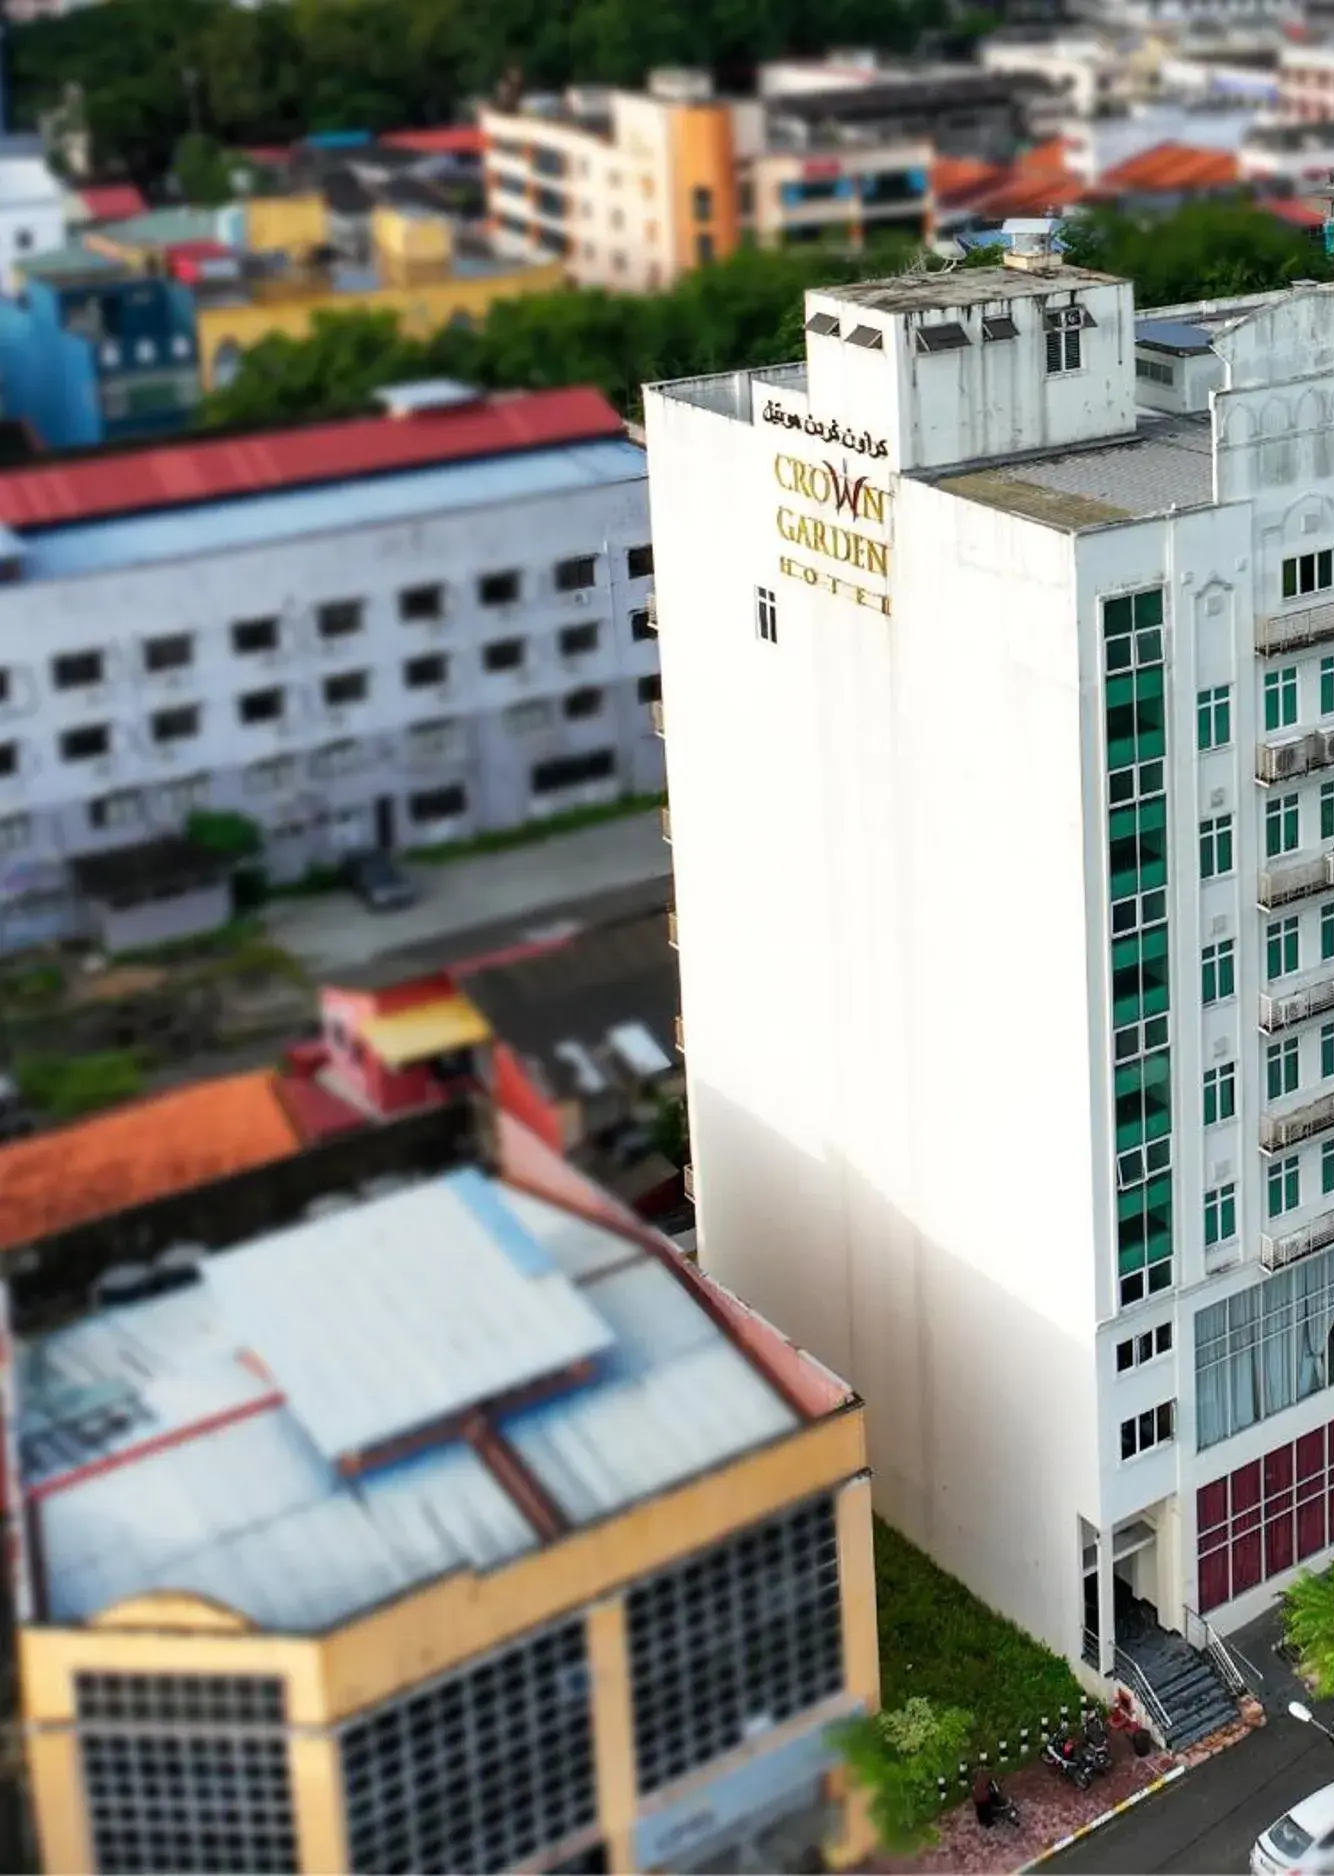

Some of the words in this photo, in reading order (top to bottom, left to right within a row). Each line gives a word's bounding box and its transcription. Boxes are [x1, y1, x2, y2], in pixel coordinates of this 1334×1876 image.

[774, 452, 885, 524] CROWN
[776, 505, 888, 577] GARDEN
[780, 555, 892, 617] HOTEL
